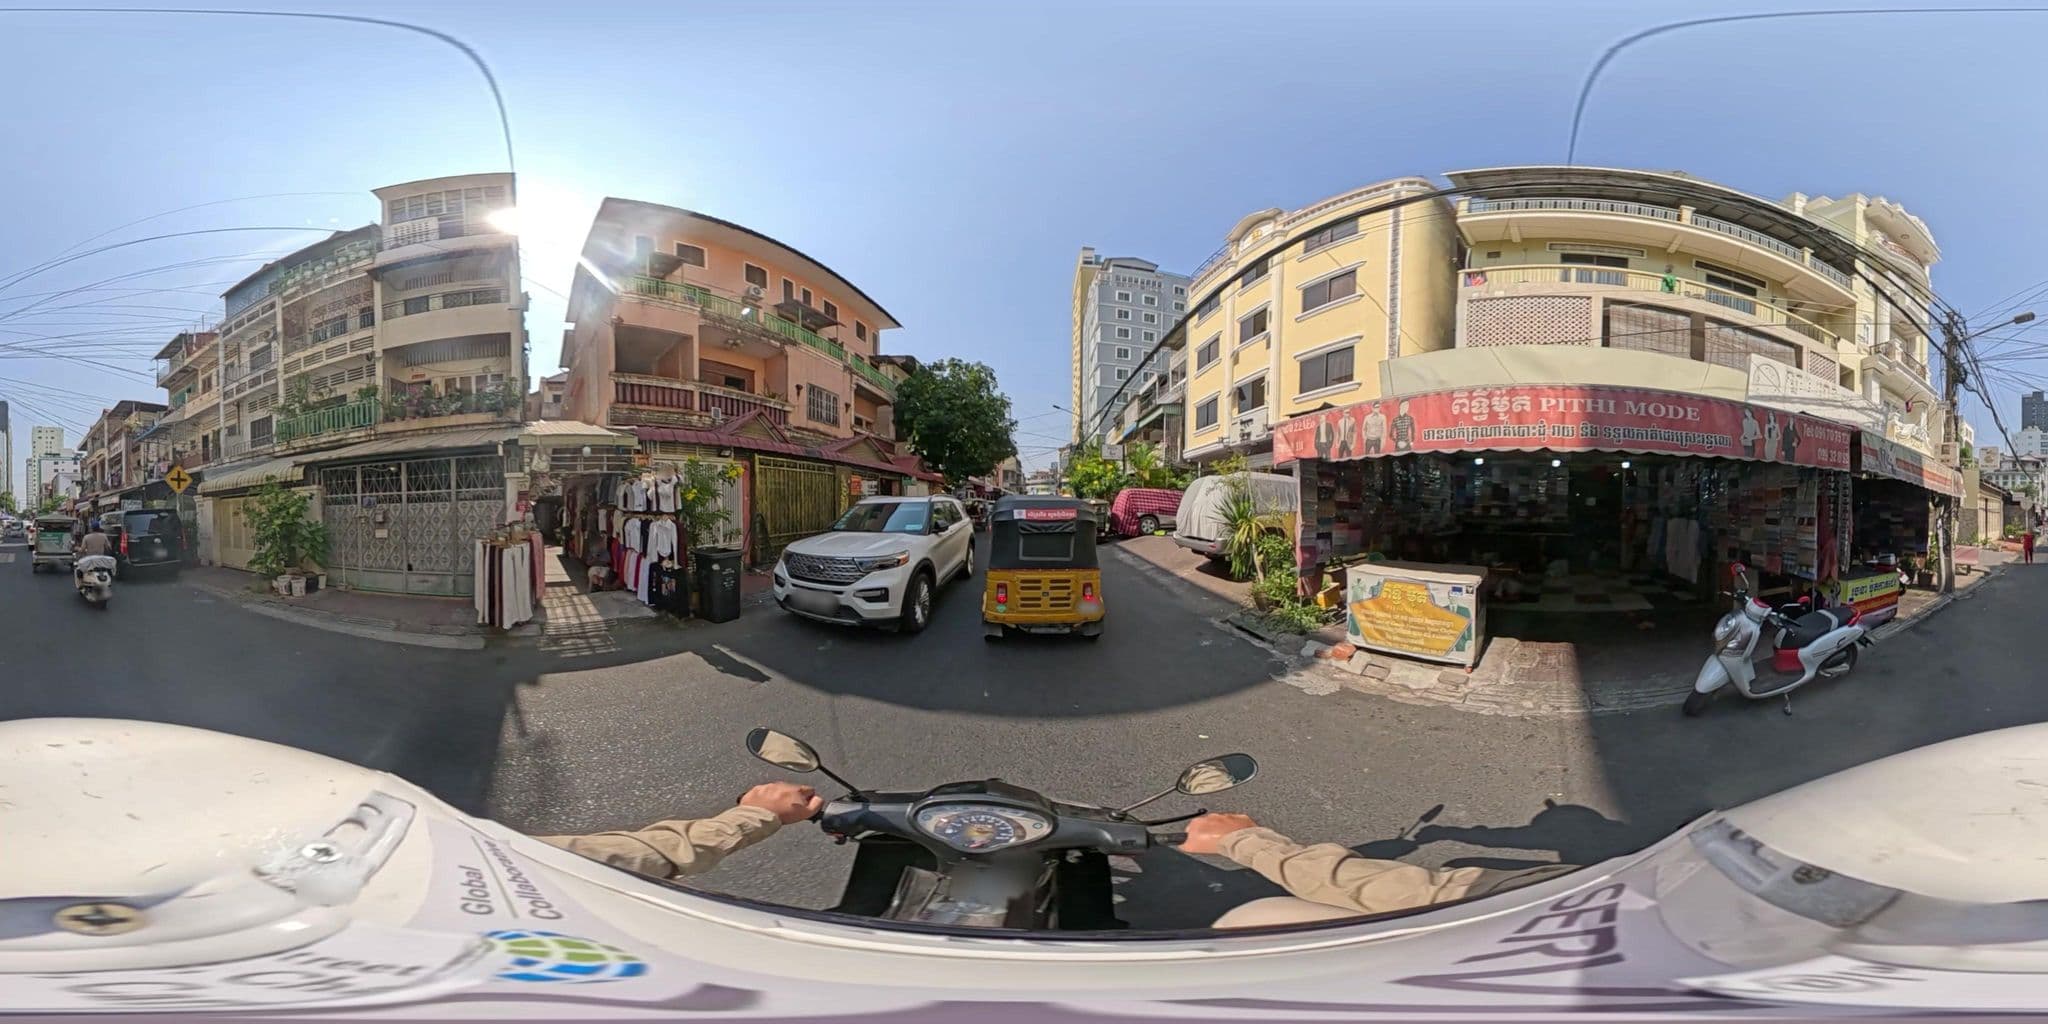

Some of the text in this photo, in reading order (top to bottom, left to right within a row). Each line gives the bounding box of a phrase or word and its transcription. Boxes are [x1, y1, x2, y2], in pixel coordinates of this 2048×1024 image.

[1540, 396, 1617, 415] PITHI
[1623, 400, 1701, 421] MODE
[459, 865, 494, 915] Global
